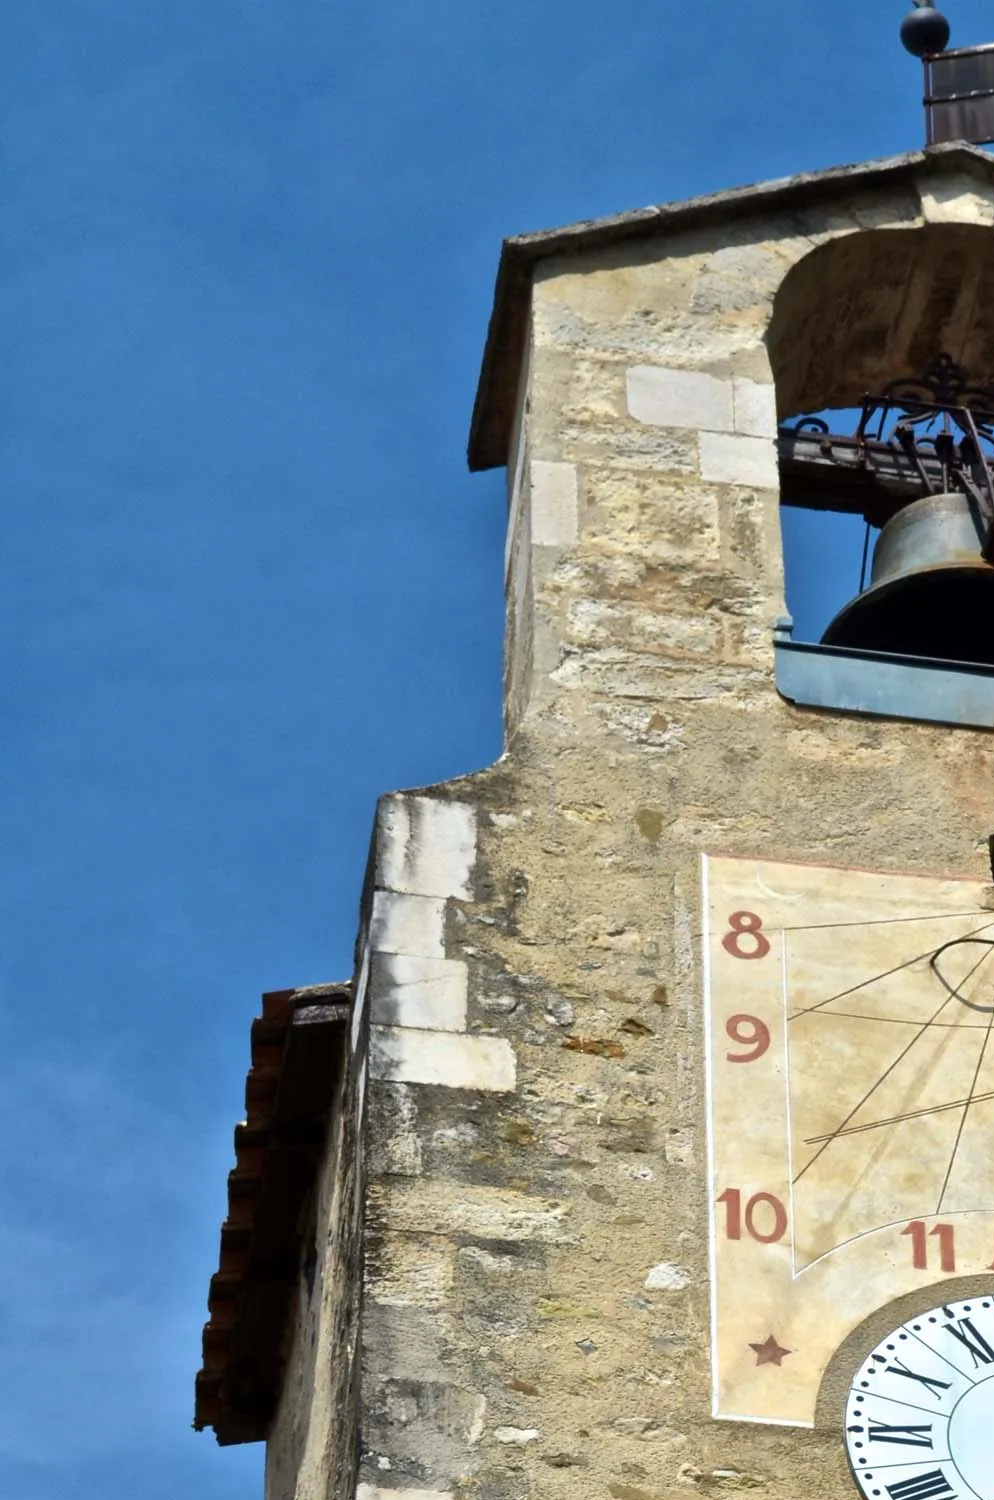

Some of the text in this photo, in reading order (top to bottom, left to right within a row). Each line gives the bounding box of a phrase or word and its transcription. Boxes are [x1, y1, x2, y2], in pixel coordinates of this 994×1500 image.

[722, 911, 771, 960] 8
[725, 1014, 771, 1063] 9
[716, 1189, 788, 1244] 10
[902, 1221, 955, 1272] 11
[884, 1356, 953, 1401] X
[867, 1417, 934, 1449] IX
